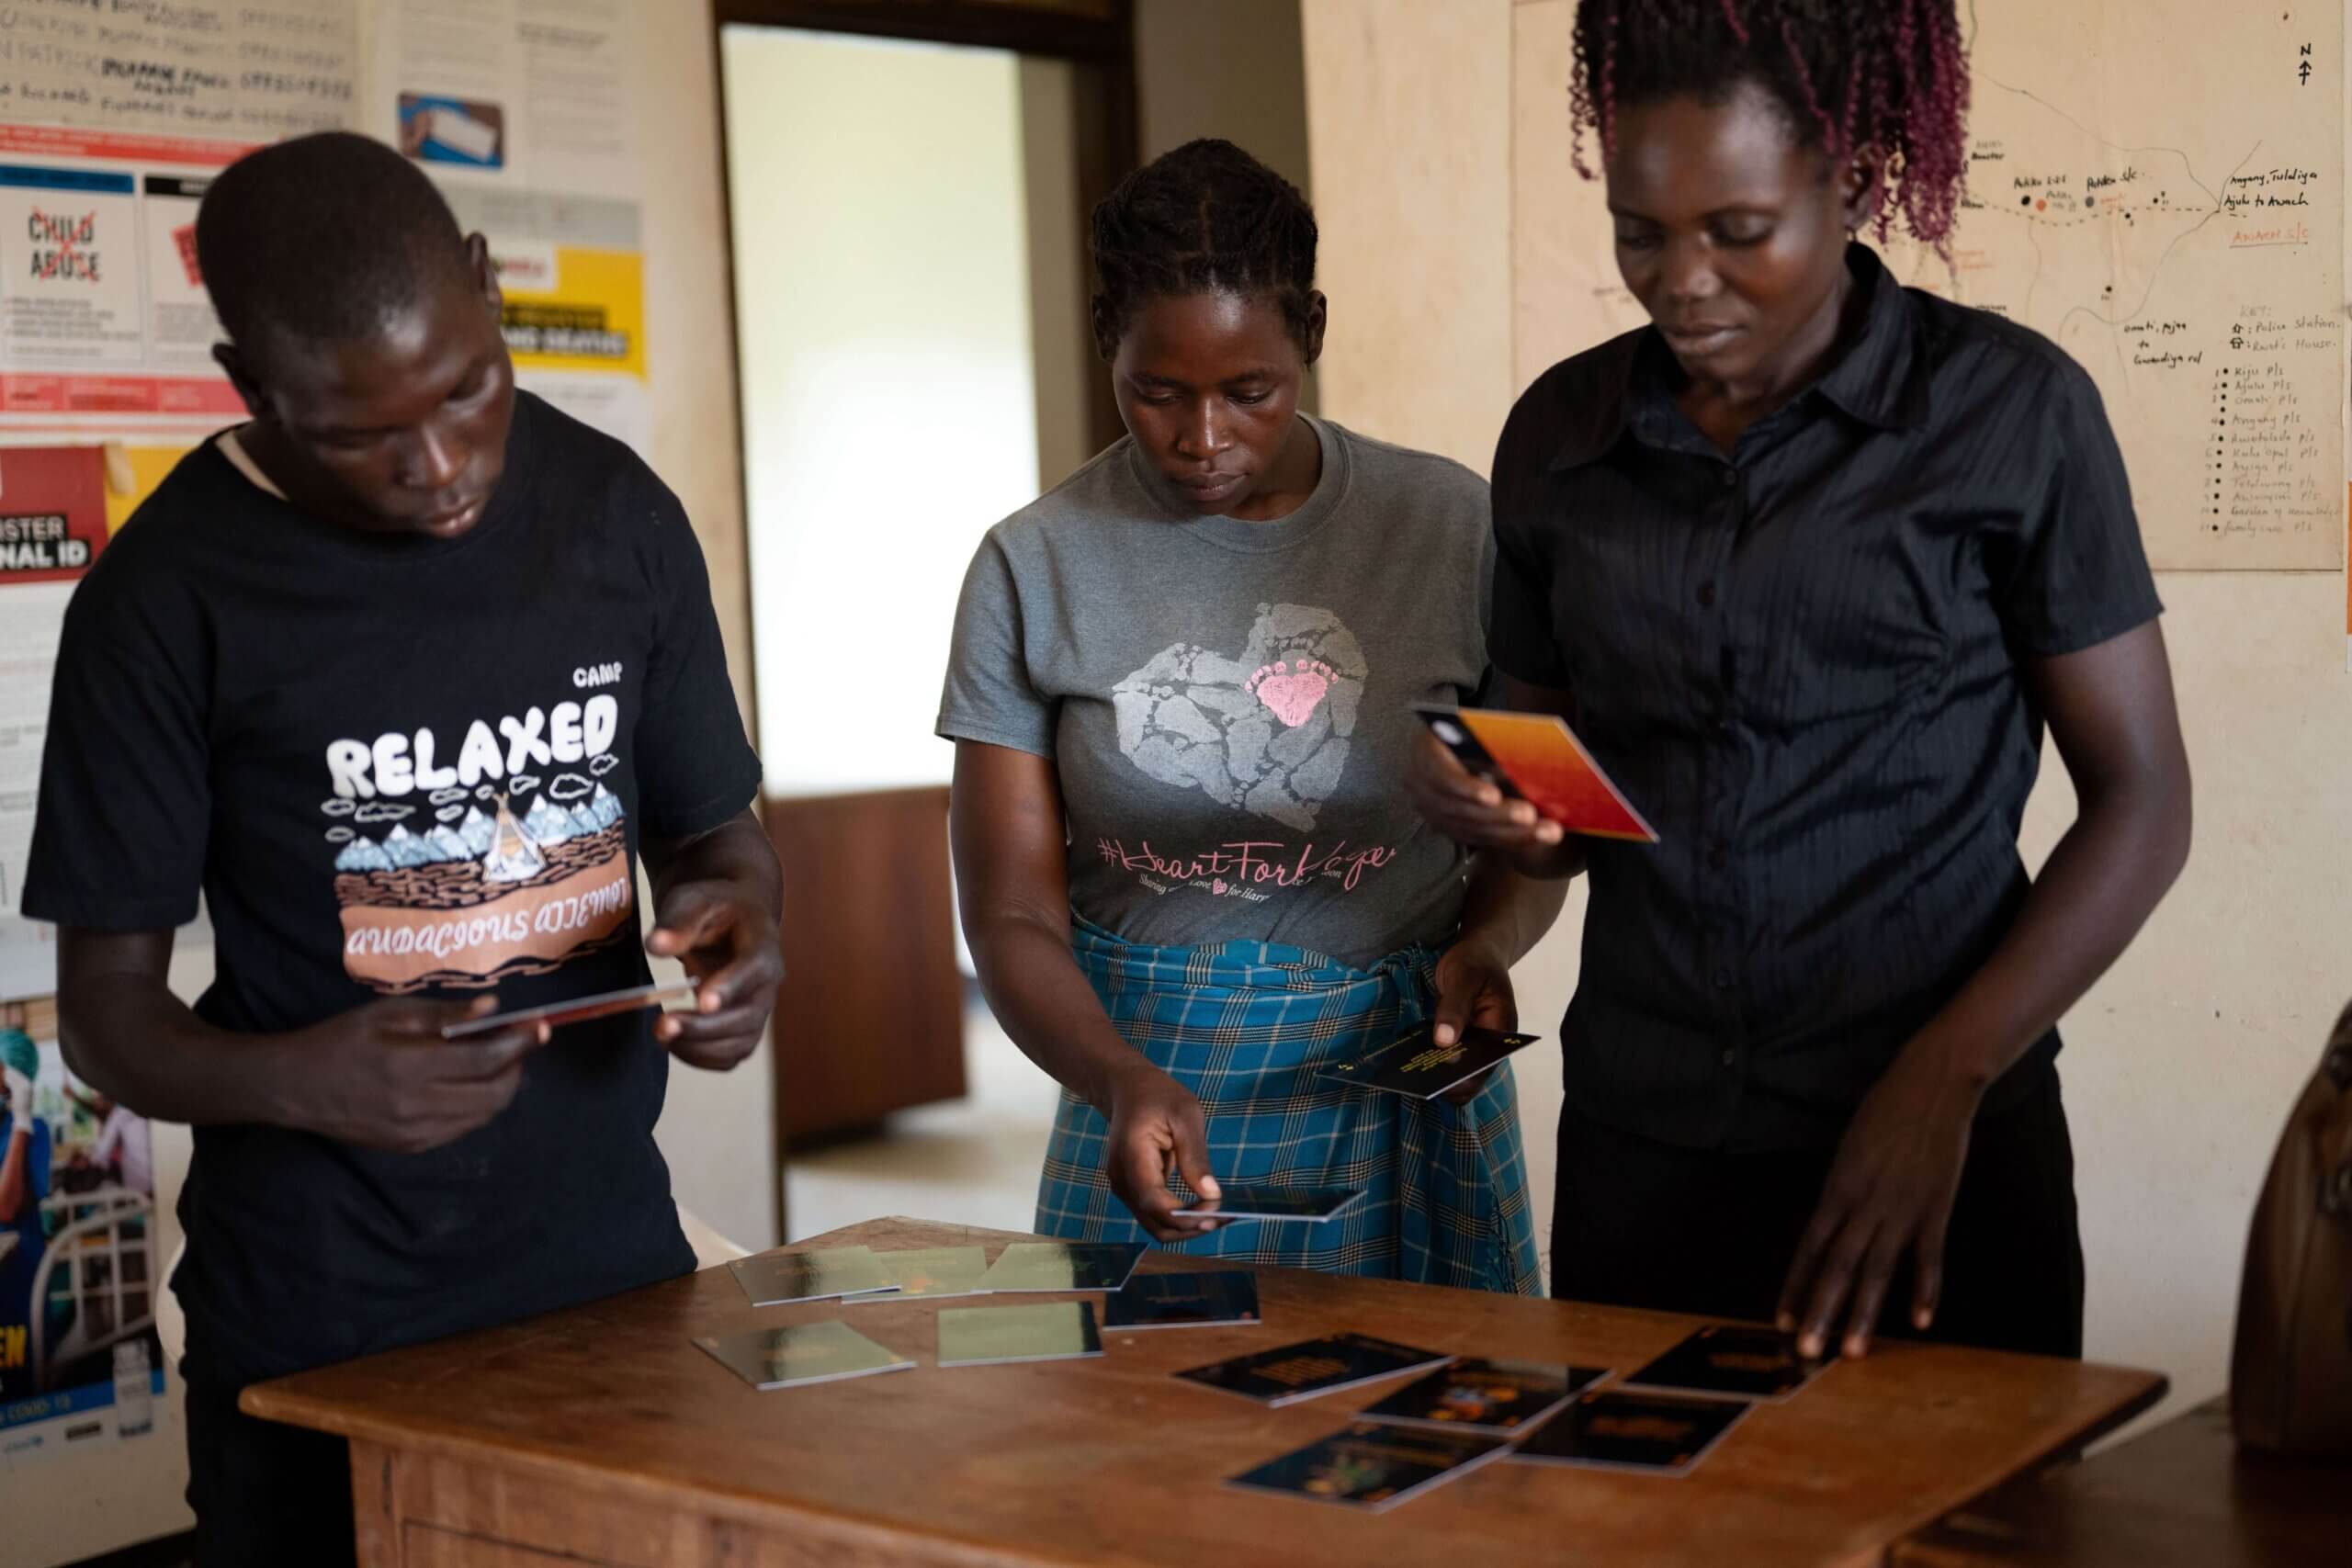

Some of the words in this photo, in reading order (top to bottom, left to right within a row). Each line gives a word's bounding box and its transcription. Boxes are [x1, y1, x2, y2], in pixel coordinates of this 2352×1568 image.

[2300, 43, 2312, 55] N
[2256, 194, 2264, 208] to
[28, 212, 95, 244] CHILD
[31, 250, 100, 282] ABUSE
[58, 539, 88, 568] ID
[573, 661, 622, 688] CAMP
[326, 694, 618, 799] RELAXED
[1139, 874, 1168, 895] Sharing
[1224, 884, 1242, 897] for
